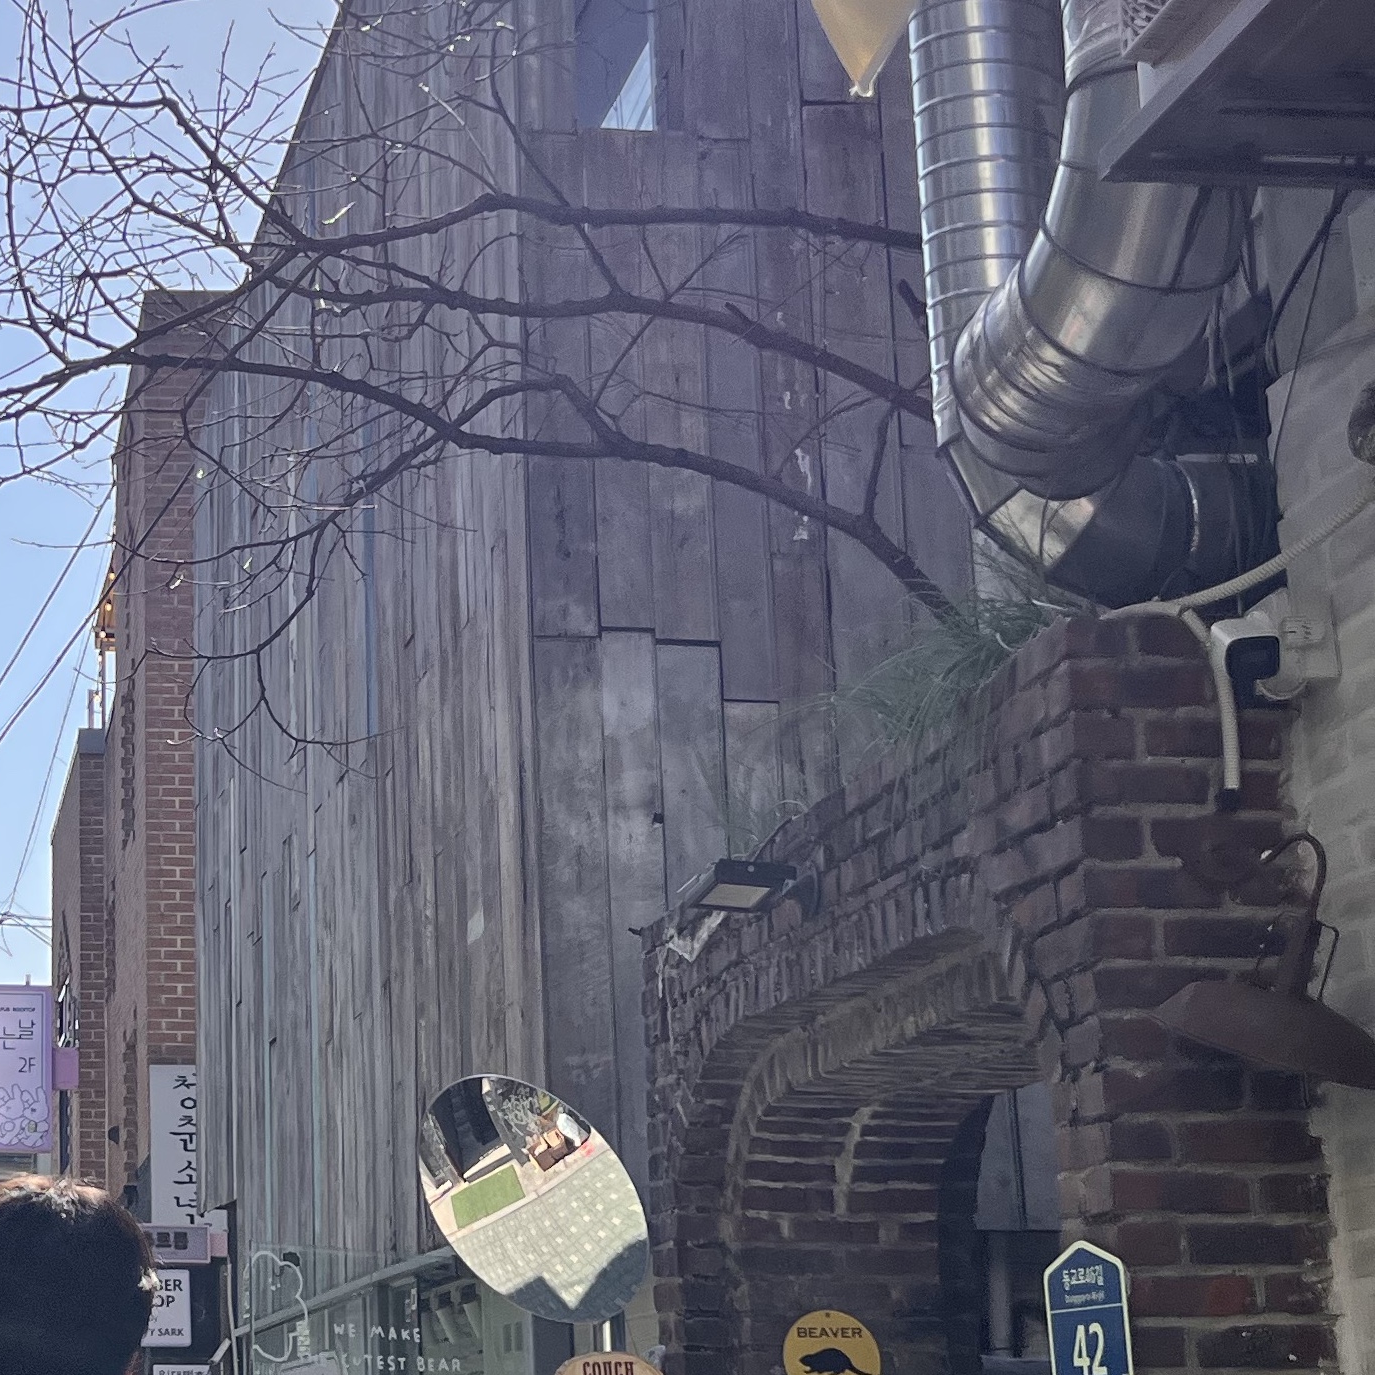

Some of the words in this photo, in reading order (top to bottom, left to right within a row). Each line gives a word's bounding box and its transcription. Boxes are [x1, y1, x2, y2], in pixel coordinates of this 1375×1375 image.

[18, 1056, 37, 1073] 2F
[157, 1328, 185, 1337] SARK
[333, 1323, 357, 1338] WE
[369, 1325, 422, 1344] MAKE
[796, 1326, 863, 1339] BEAVER
[416, 1356, 462, 1373] BEAR
